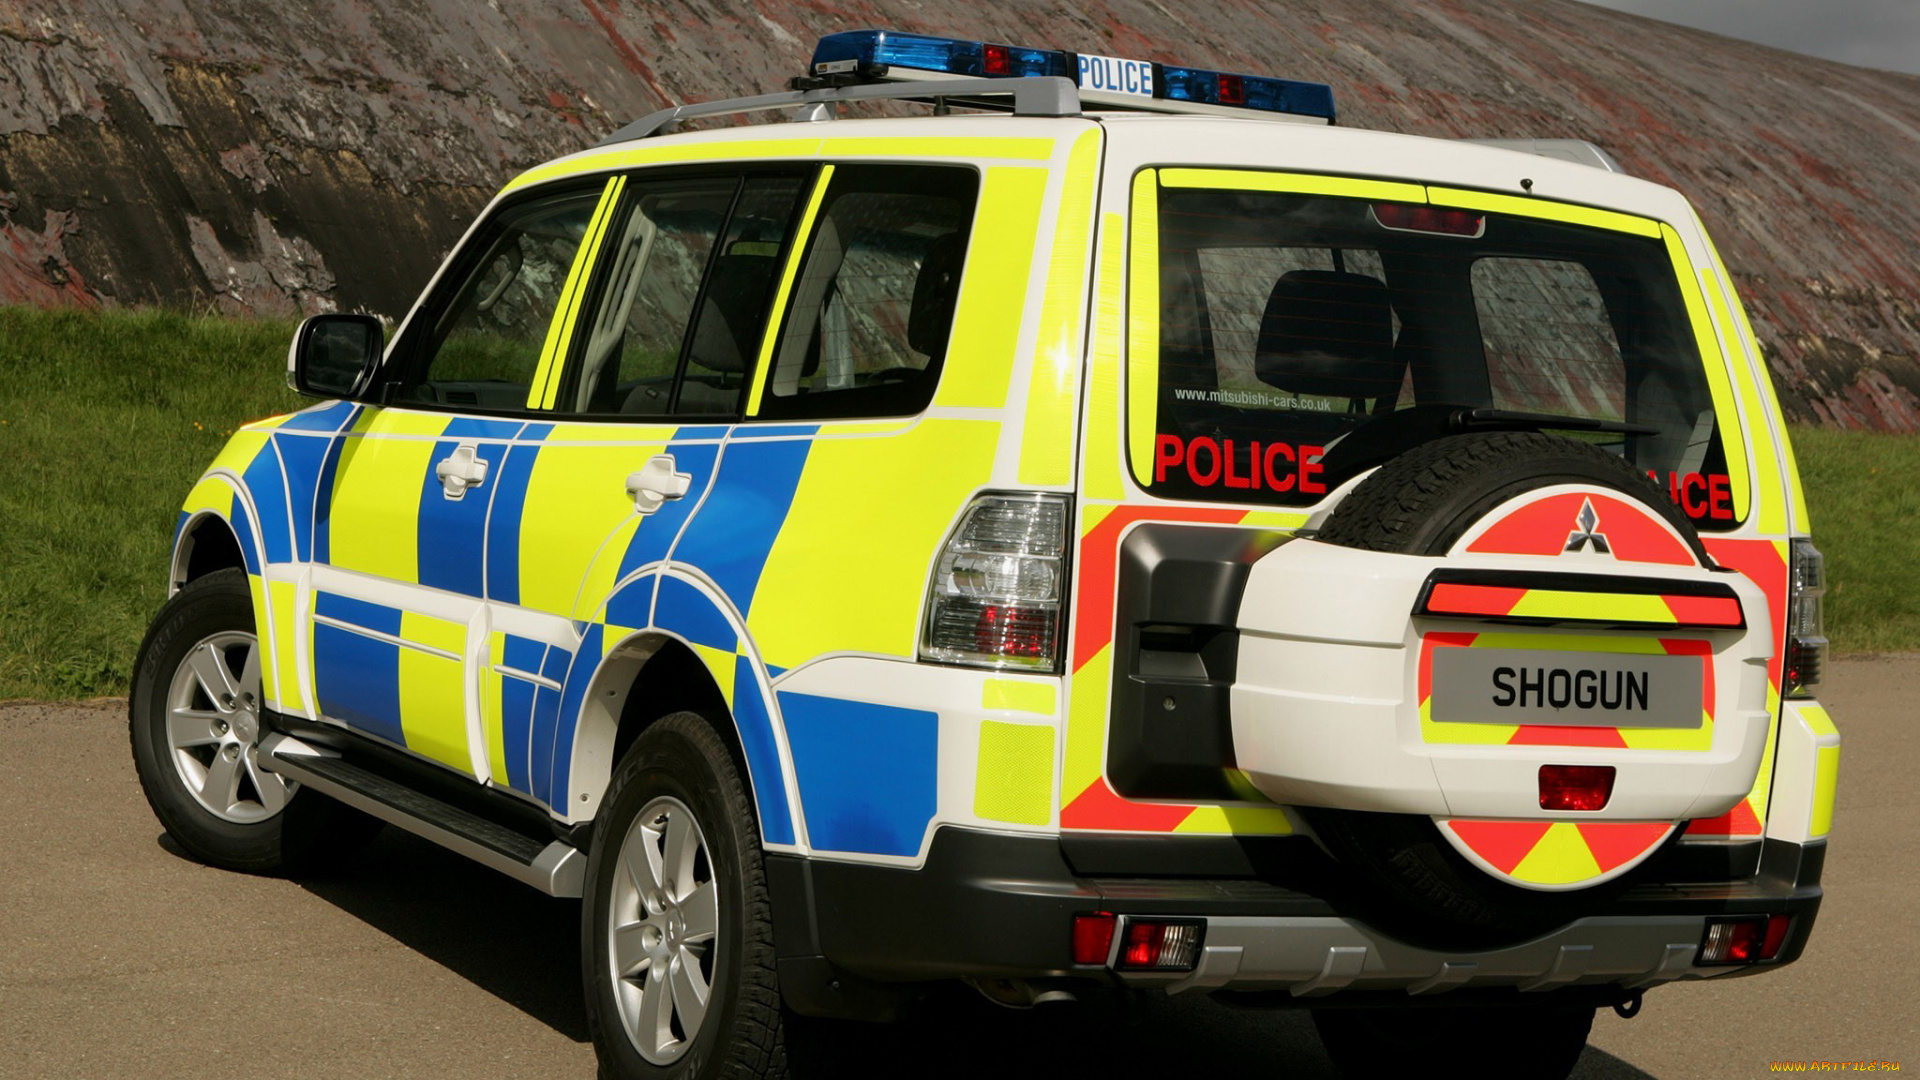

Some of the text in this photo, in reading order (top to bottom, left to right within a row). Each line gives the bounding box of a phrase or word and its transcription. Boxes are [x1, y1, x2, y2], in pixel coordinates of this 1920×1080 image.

[1077, 55, 1152, 94] POLICE
[1175, 388, 1331, 412] www.mitsubishi-cars.co.uk
[1156, 433, 1327, 494] POLICE
[1648, 470, 1733, 520] ICE
[1492, 666, 1648, 711] SHOGUN
